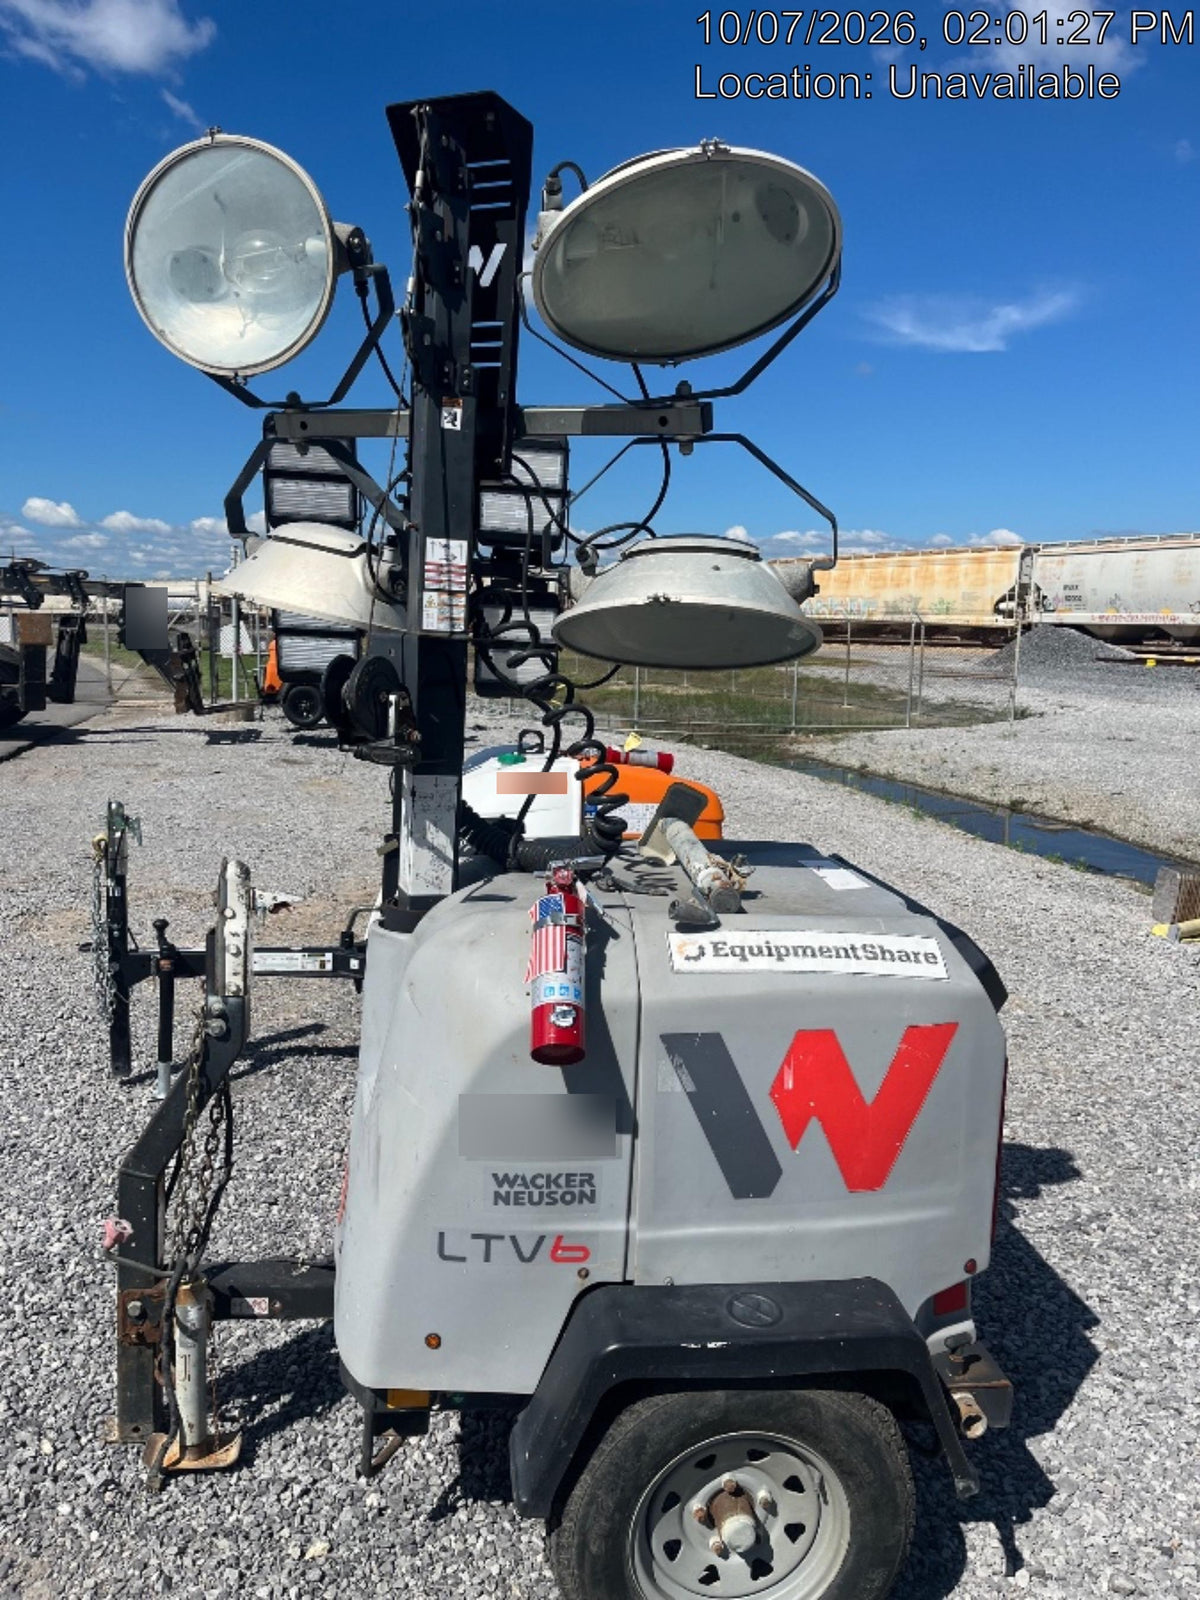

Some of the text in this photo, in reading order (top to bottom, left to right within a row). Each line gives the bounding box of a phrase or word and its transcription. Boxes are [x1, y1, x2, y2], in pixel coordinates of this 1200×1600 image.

[710, 940, 939, 965] EquipmentShare
[491, 1173, 596, 1190] WACKER
[493, 1189, 597, 1206] NEUSON
[437, 1231, 591, 1263] LTV6
